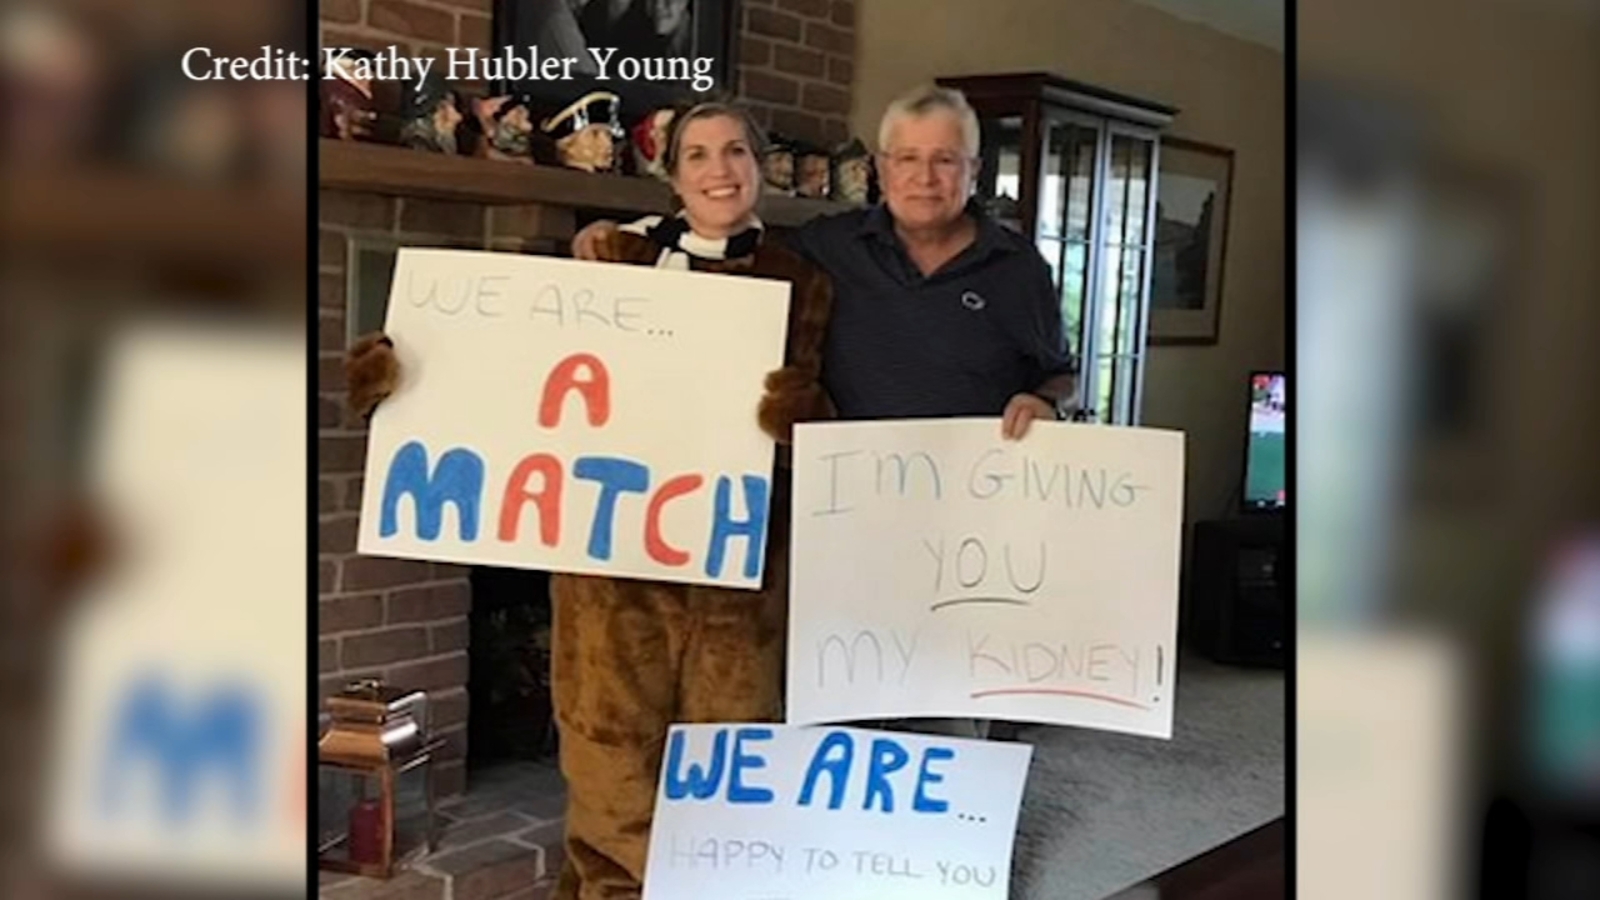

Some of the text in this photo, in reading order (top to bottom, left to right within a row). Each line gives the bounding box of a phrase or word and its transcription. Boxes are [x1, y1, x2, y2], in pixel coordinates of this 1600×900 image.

[405, 273, 511, 318] WE
[538, 353, 610, 428] A
[379, 441, 768, 579] MATCH
[968, 449, 1151, 509] GIVING
[923, 536, 1047, 594] YOU
[817, 627, 1164, 702] MY KIDNEY!
[663, 728, 775, 804] WE
[668, 833, 996, 888] HAPPY TO TELL YOU
